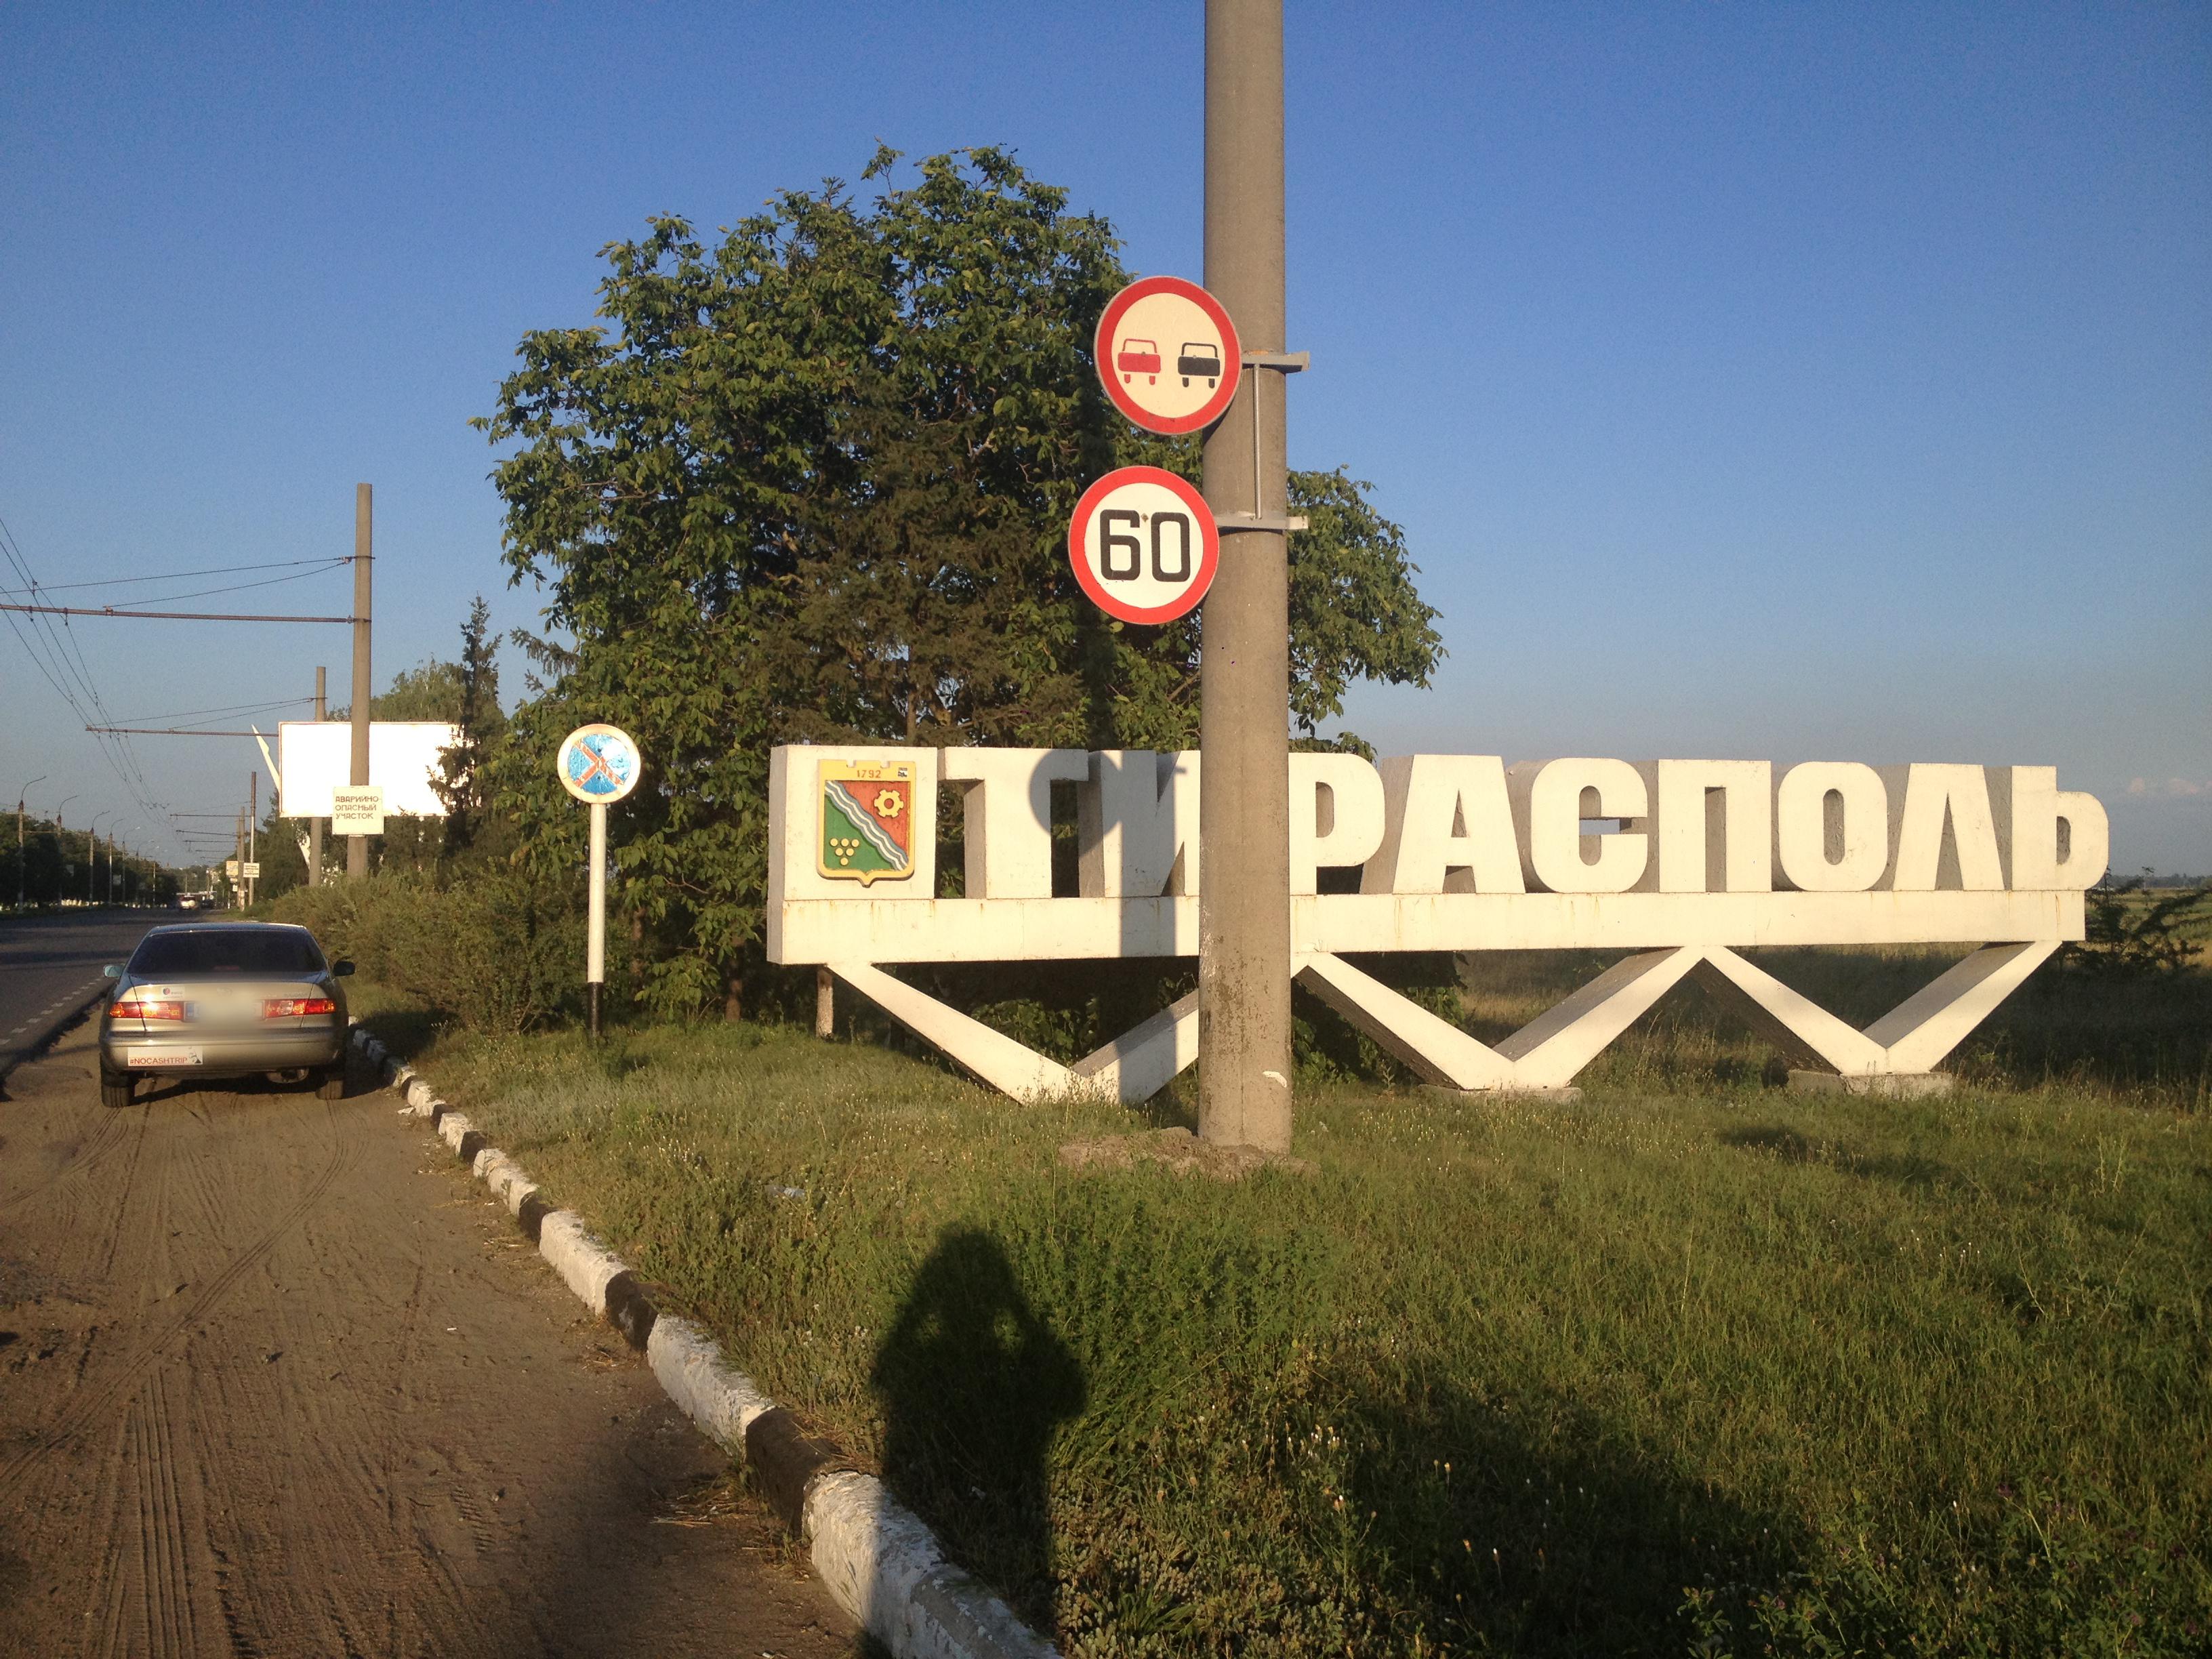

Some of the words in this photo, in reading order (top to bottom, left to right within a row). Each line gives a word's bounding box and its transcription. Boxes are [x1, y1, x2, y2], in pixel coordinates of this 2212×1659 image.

[1099, 509, 1191, 583] 60
[857, 770, 882, 779] 1792
[945, 746, 2110, 899] ТИРАСПОЛЬ
